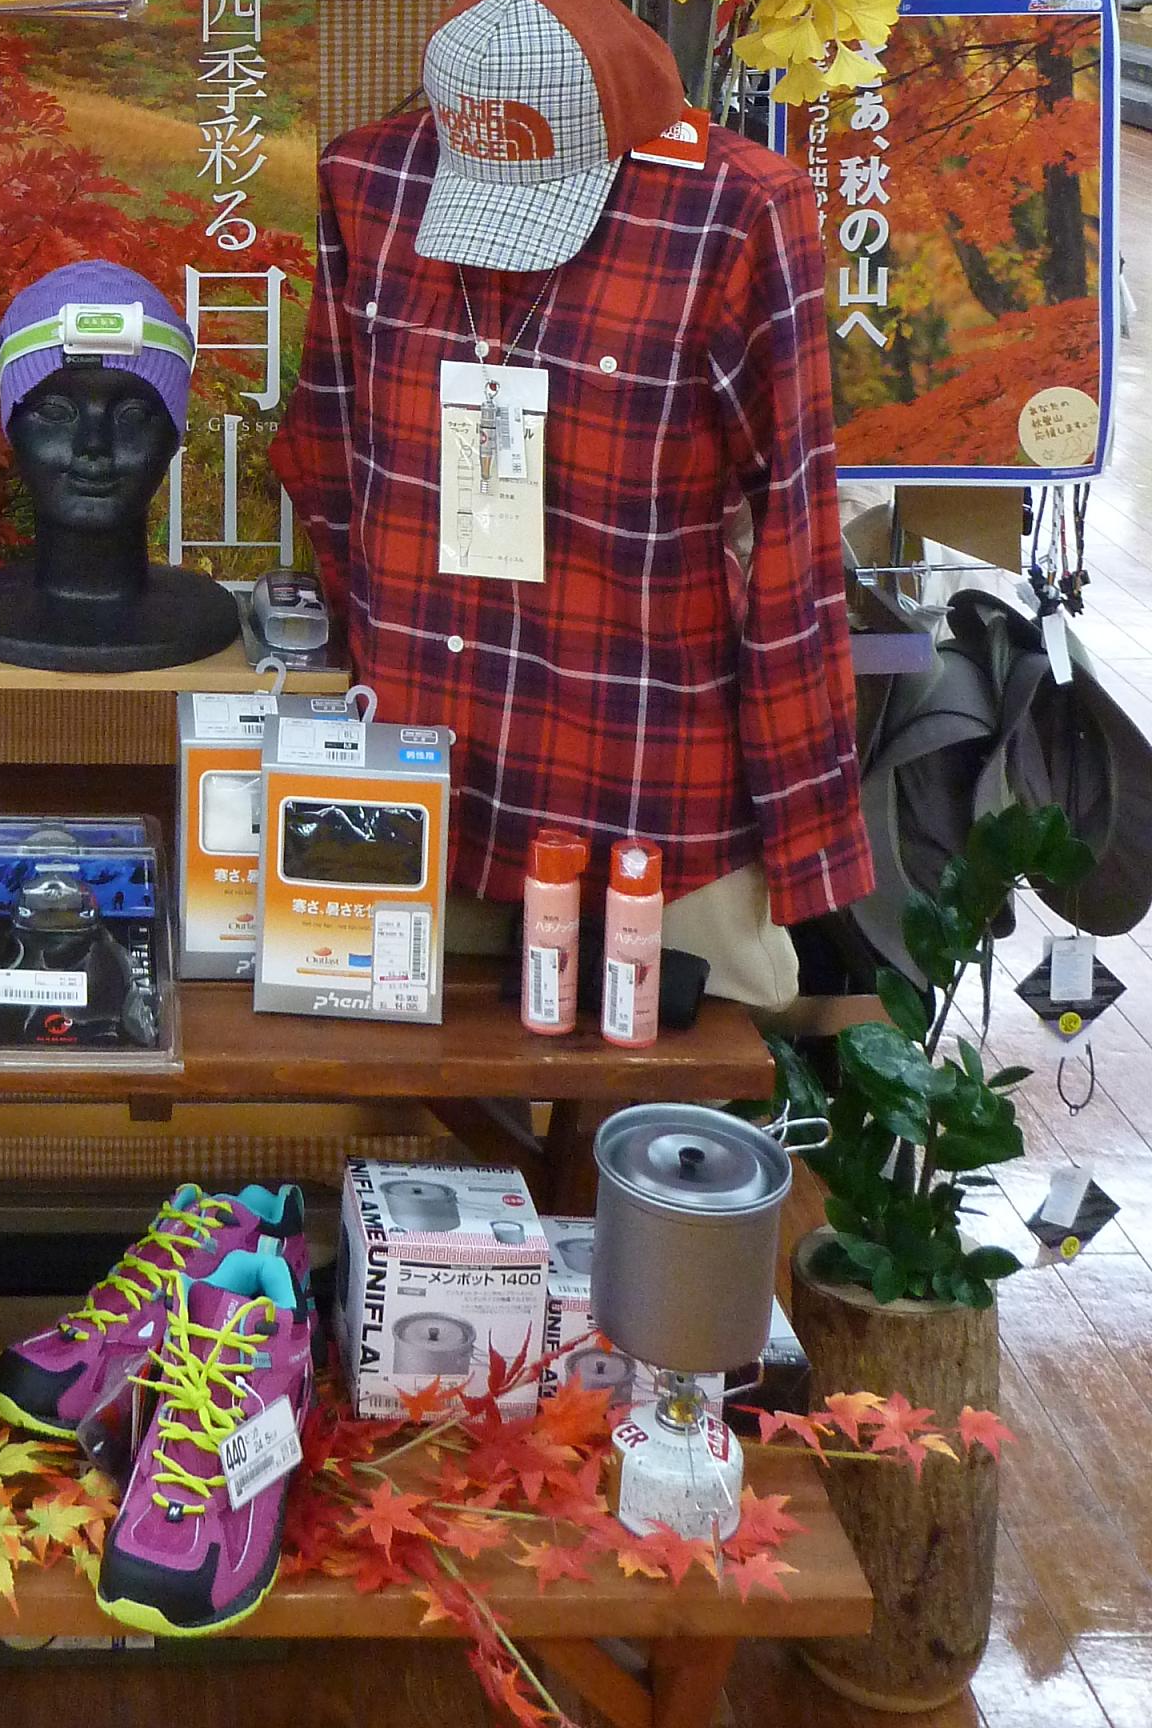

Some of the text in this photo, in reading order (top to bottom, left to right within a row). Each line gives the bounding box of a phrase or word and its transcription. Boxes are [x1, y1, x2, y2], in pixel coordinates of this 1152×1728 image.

[456, 92, 504, 121] THE
[437, 104, 505, 143] NORTH
[448, 128, 508, 161] FACE
[208, 417, 279, 432] Gassa
[305, 955, 339, 965] Outlast
[312, 991, 371, 1010] pheni
[348, 1158, 389, 1247] NIFLAME
[399, 1268, 541, 1287] ラーメンポット 1400
[224, 1435, 248, 1471] 440
